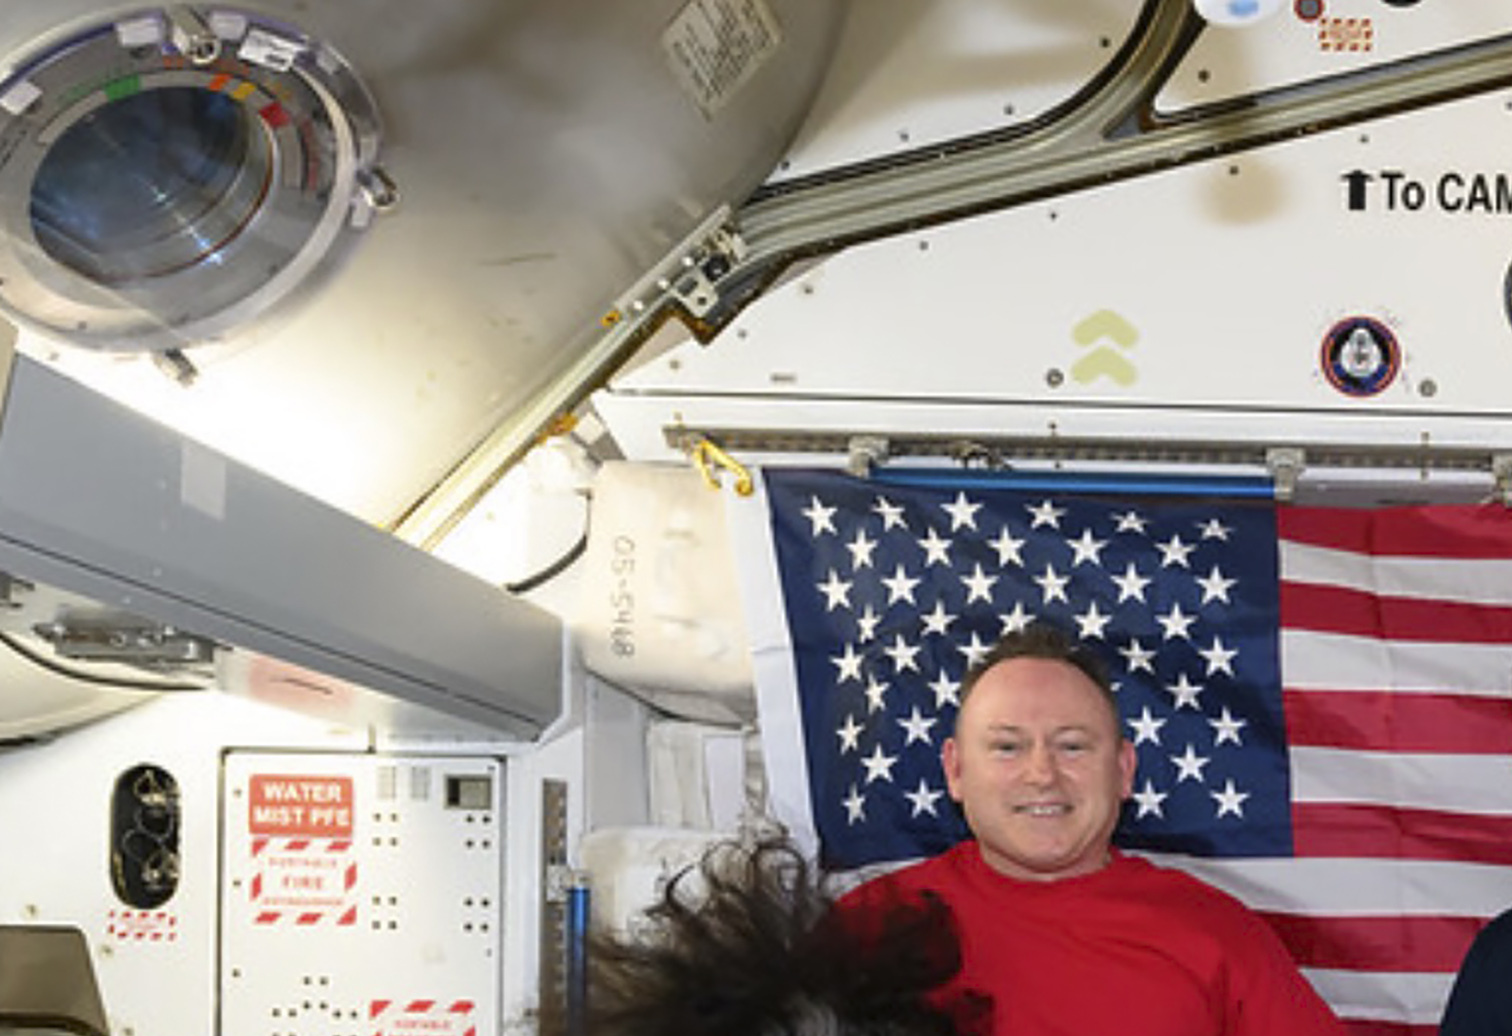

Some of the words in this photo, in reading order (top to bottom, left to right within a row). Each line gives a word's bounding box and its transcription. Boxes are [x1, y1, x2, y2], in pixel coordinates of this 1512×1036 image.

[1380, 171, 1425, 211] To
[264, 782, 342, 802] WATER
[254, 806, 304, 826] MIST
[311, 807, 350, 827] PFE
[283, 876, 322, 889] FIRE
